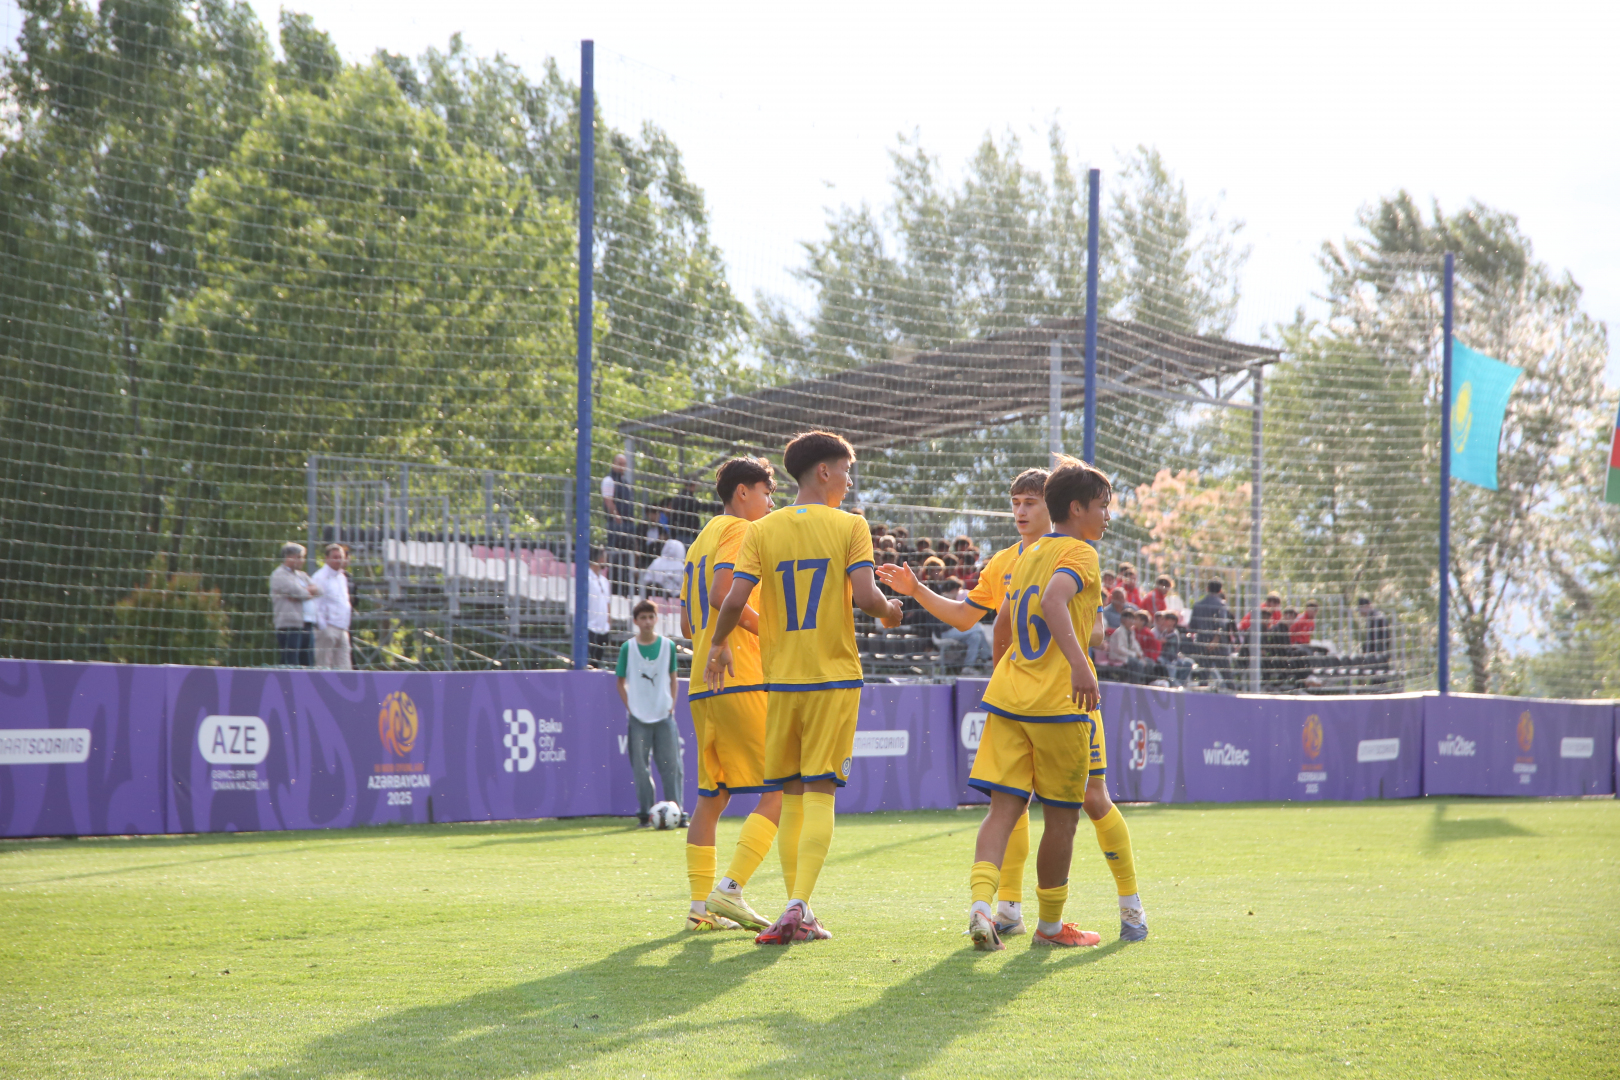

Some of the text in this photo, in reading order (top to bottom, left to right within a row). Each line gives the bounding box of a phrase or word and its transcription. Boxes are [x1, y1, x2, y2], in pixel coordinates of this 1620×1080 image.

[775, 557, 831, 632] 17
[538, 718, 563, 733] Baku
[211, 724, 257, 755] AZE
[538, 733, 556, 751] city
[853, 736, 905, 750] MARTSCORING
[538, 747, 567, 762] circuit
[1202, 741, 1250, 766] win2tec
[387, 791, 413, 806] 2025
